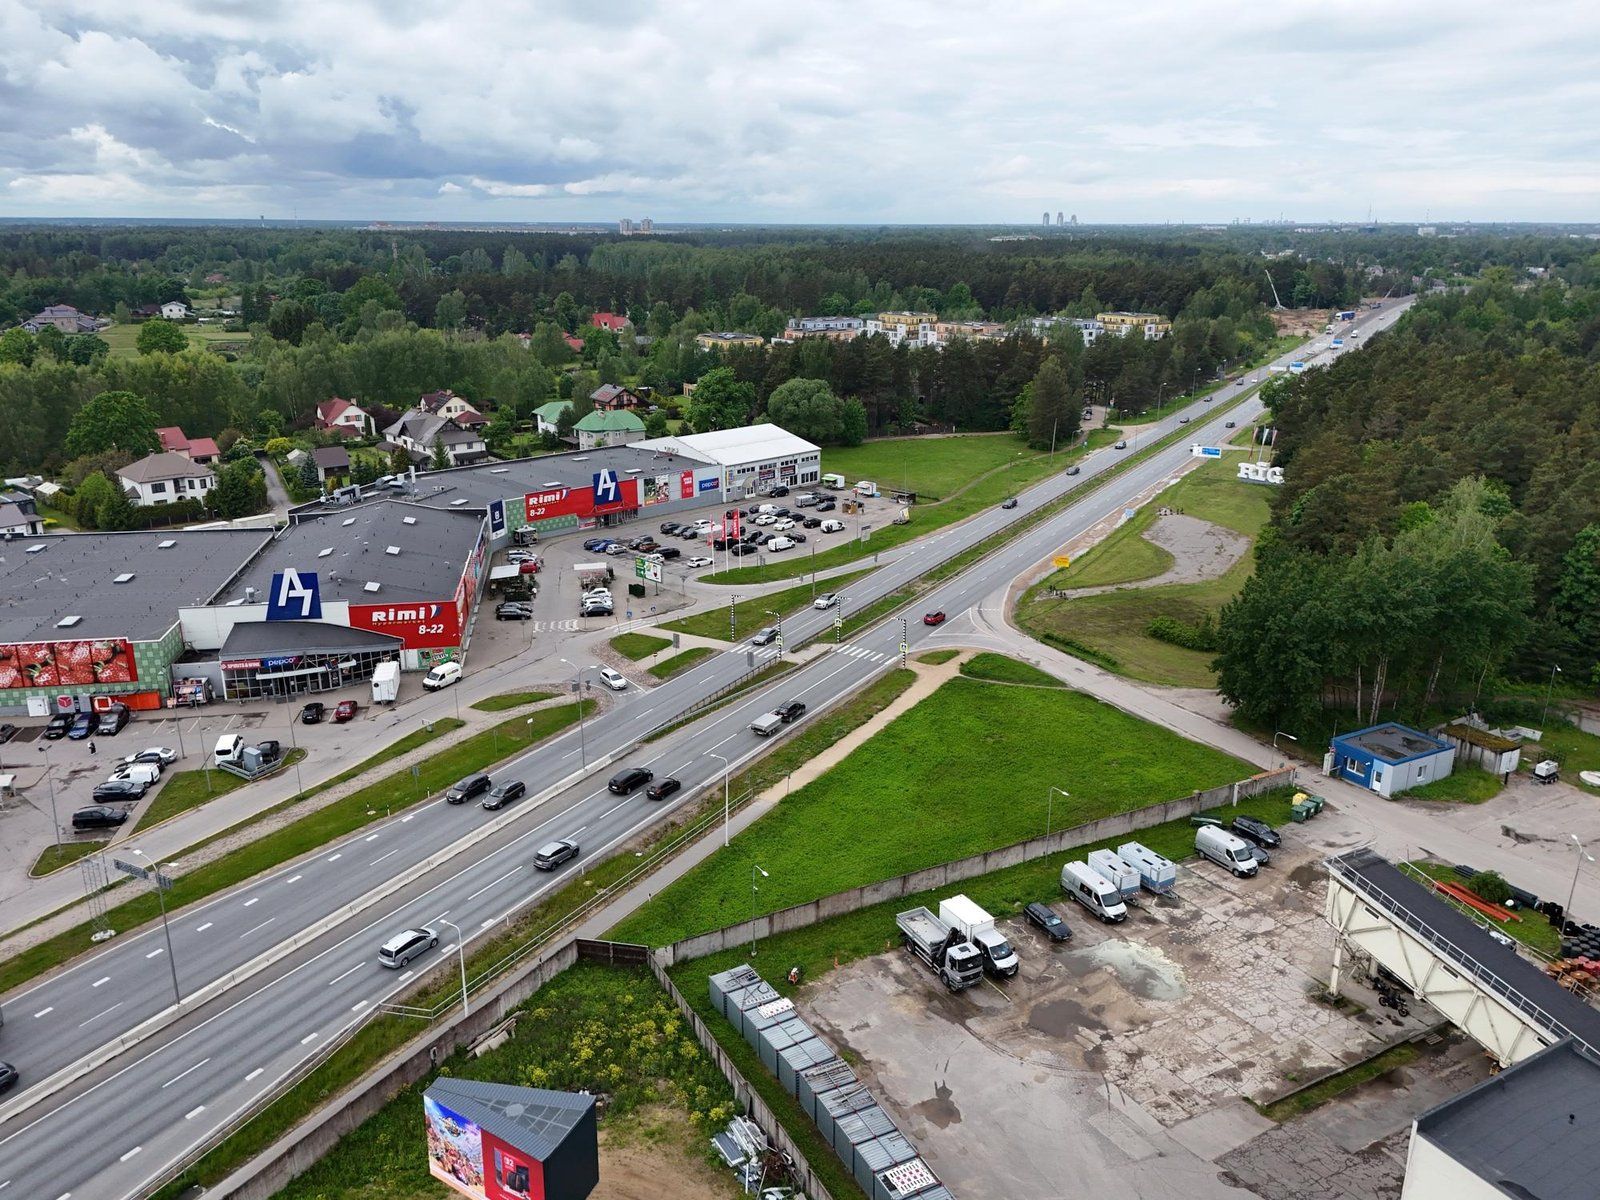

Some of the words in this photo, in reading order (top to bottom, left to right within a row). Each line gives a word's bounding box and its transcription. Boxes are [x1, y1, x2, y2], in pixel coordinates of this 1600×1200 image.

[529, 491, 561, 505] Rimi
[530, 507, 546, 517] 8-22
[372, 606, 426, 621] Rimi
[418, 623, 444, 635] 8-22
[268, 658, 293, 666] pepco
